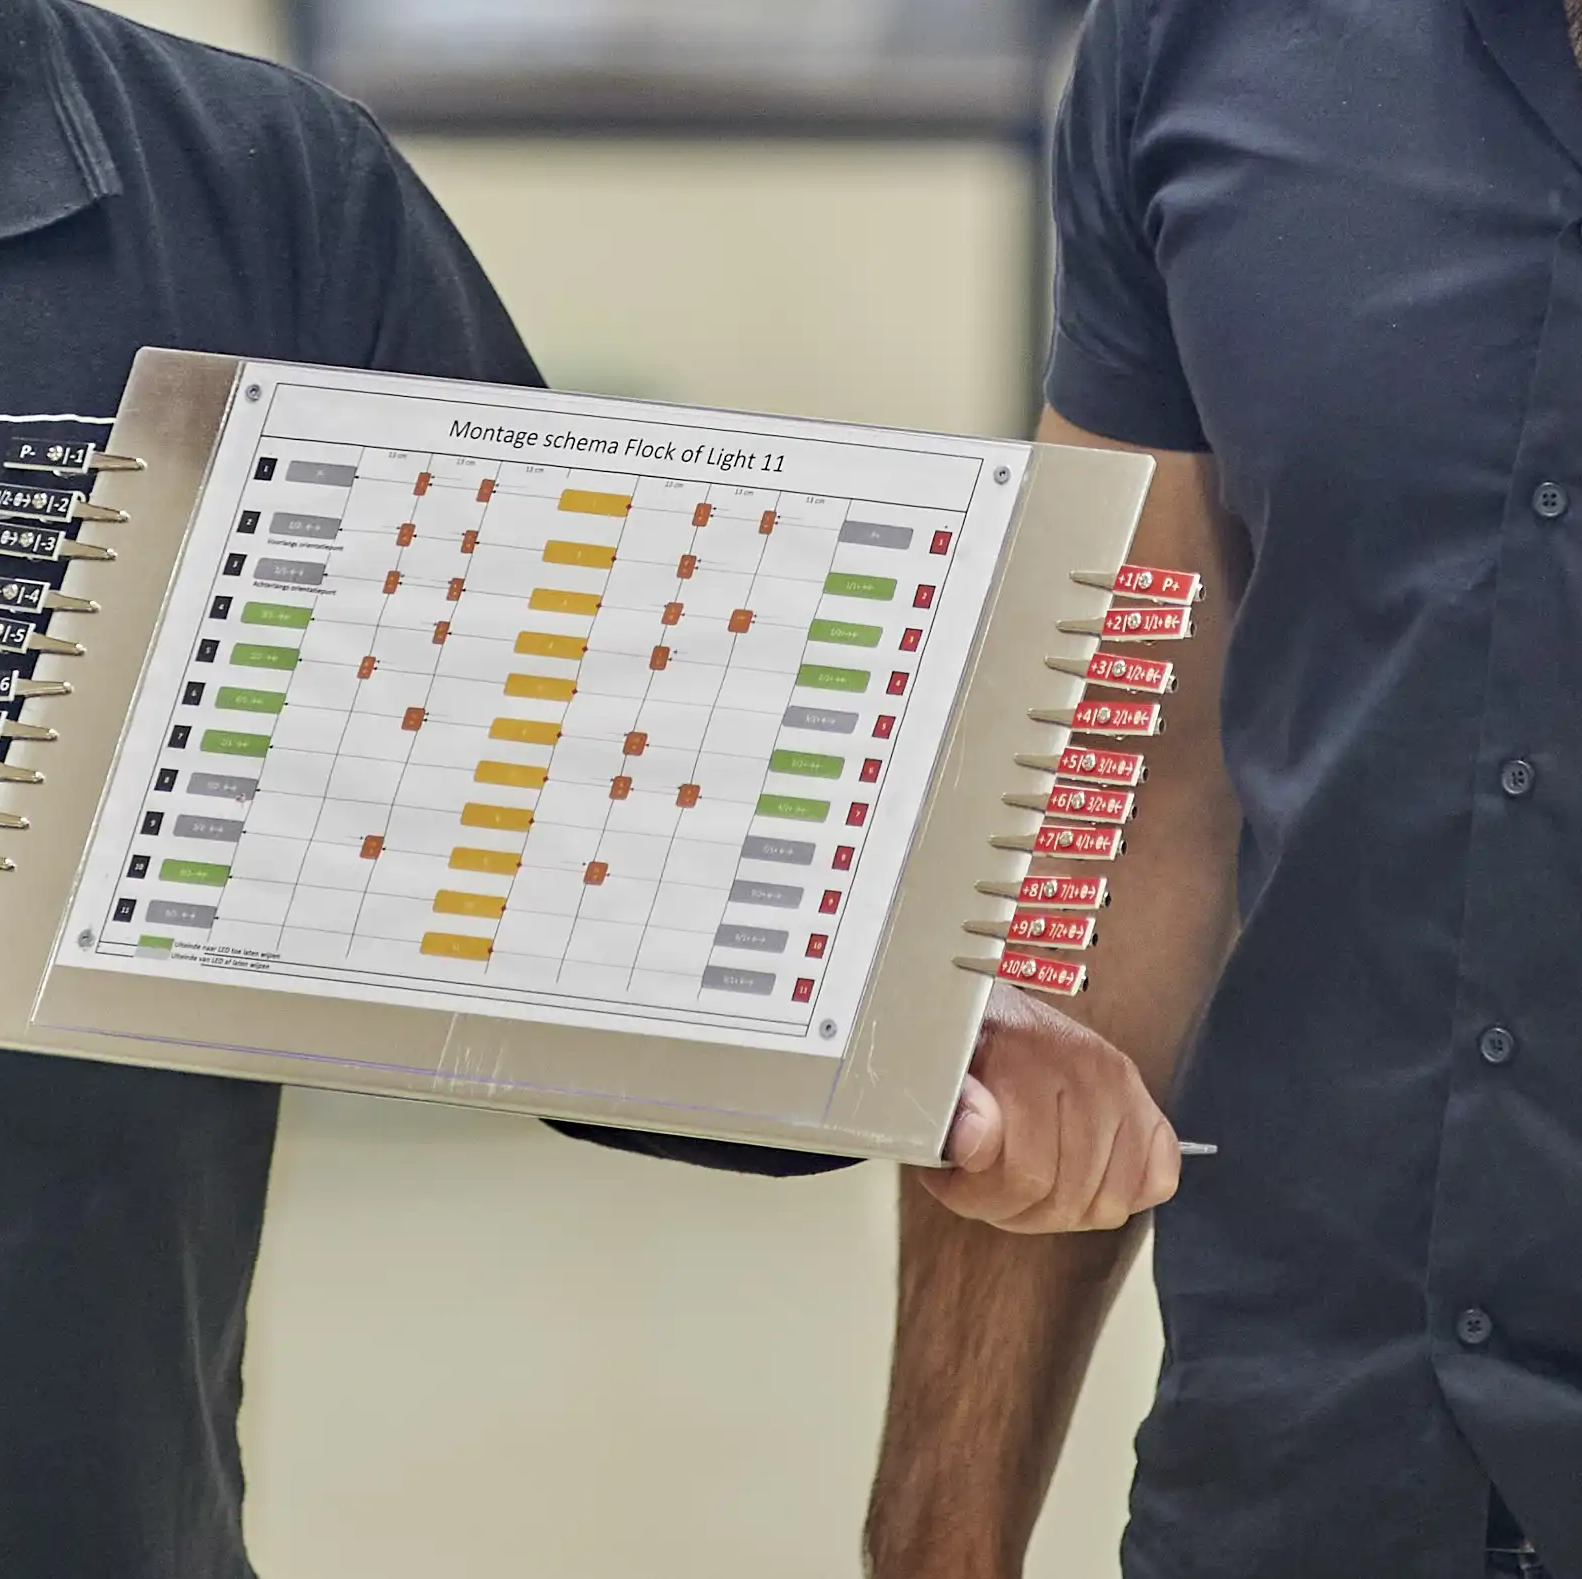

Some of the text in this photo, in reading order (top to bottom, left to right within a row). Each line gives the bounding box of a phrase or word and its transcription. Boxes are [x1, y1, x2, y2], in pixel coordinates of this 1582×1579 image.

[448, 419, 786, 473] Montage schema Flock of Light 11
